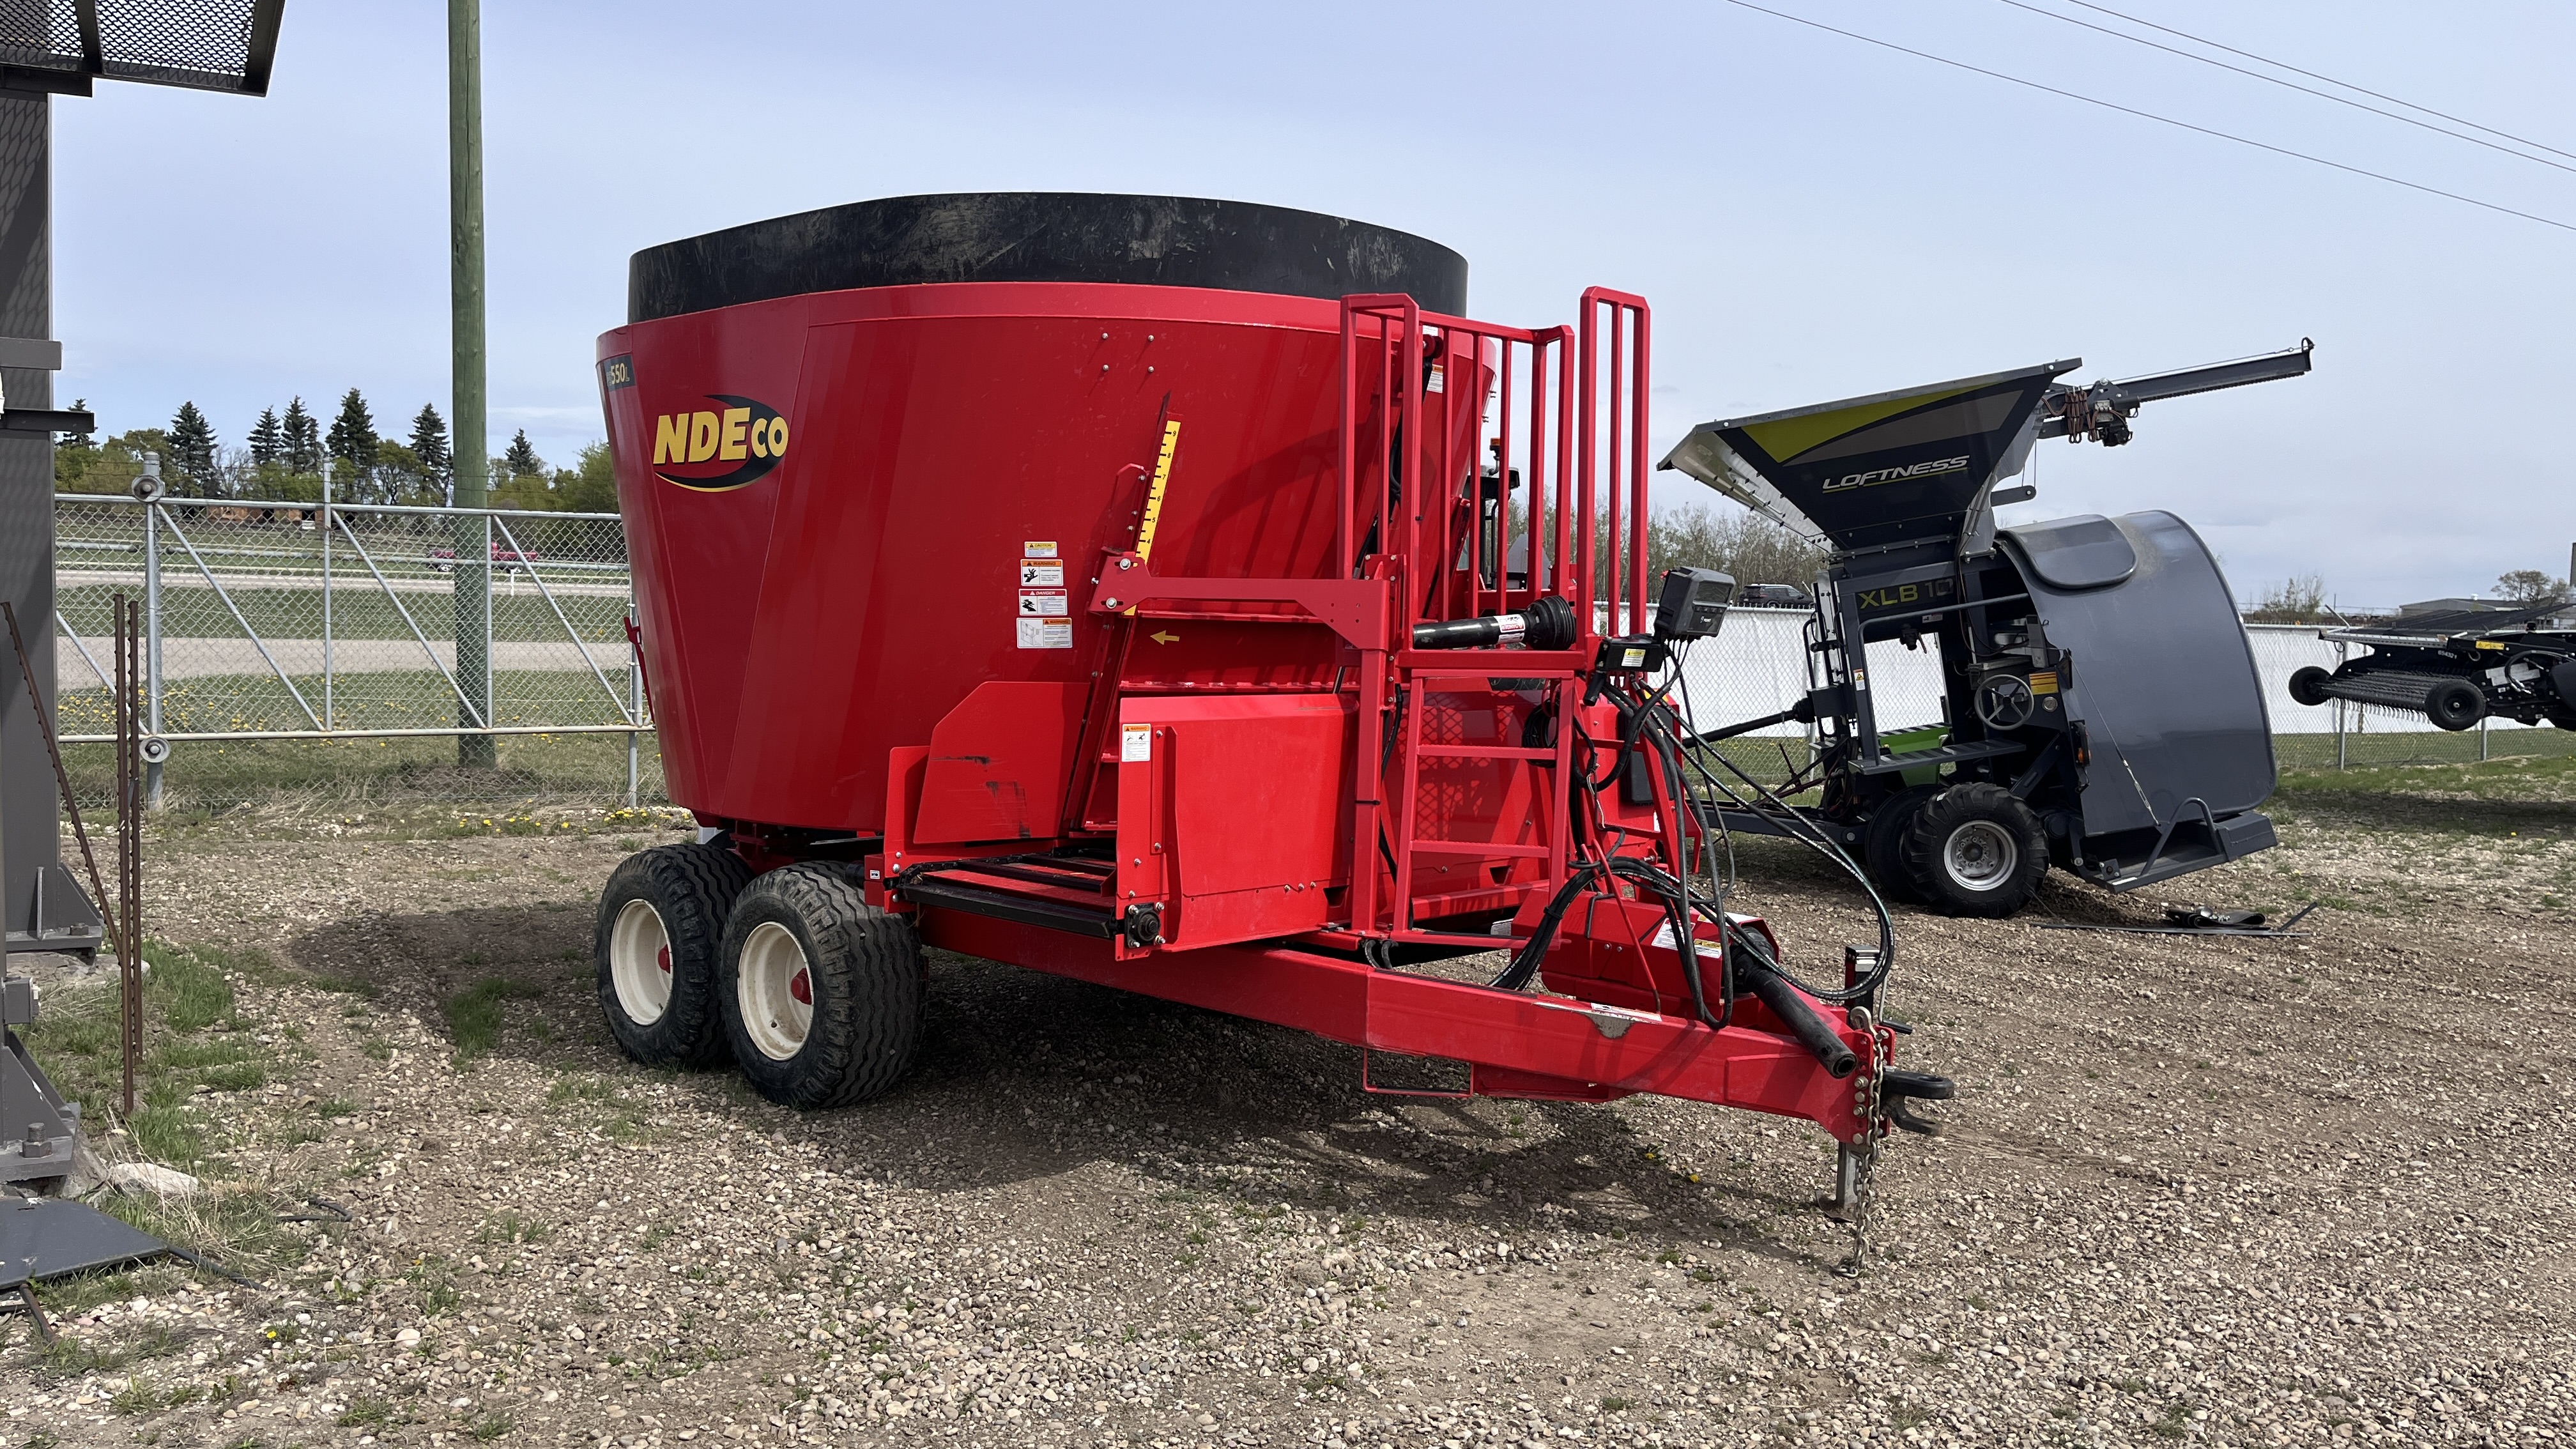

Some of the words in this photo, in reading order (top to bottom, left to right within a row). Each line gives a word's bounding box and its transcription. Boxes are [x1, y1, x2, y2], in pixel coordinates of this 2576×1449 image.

[1822, 455, 1970, 490] LOFTNESS
[1858, 584, 1919, 610] XLB
[1924, 578, 1954, 598] 10
